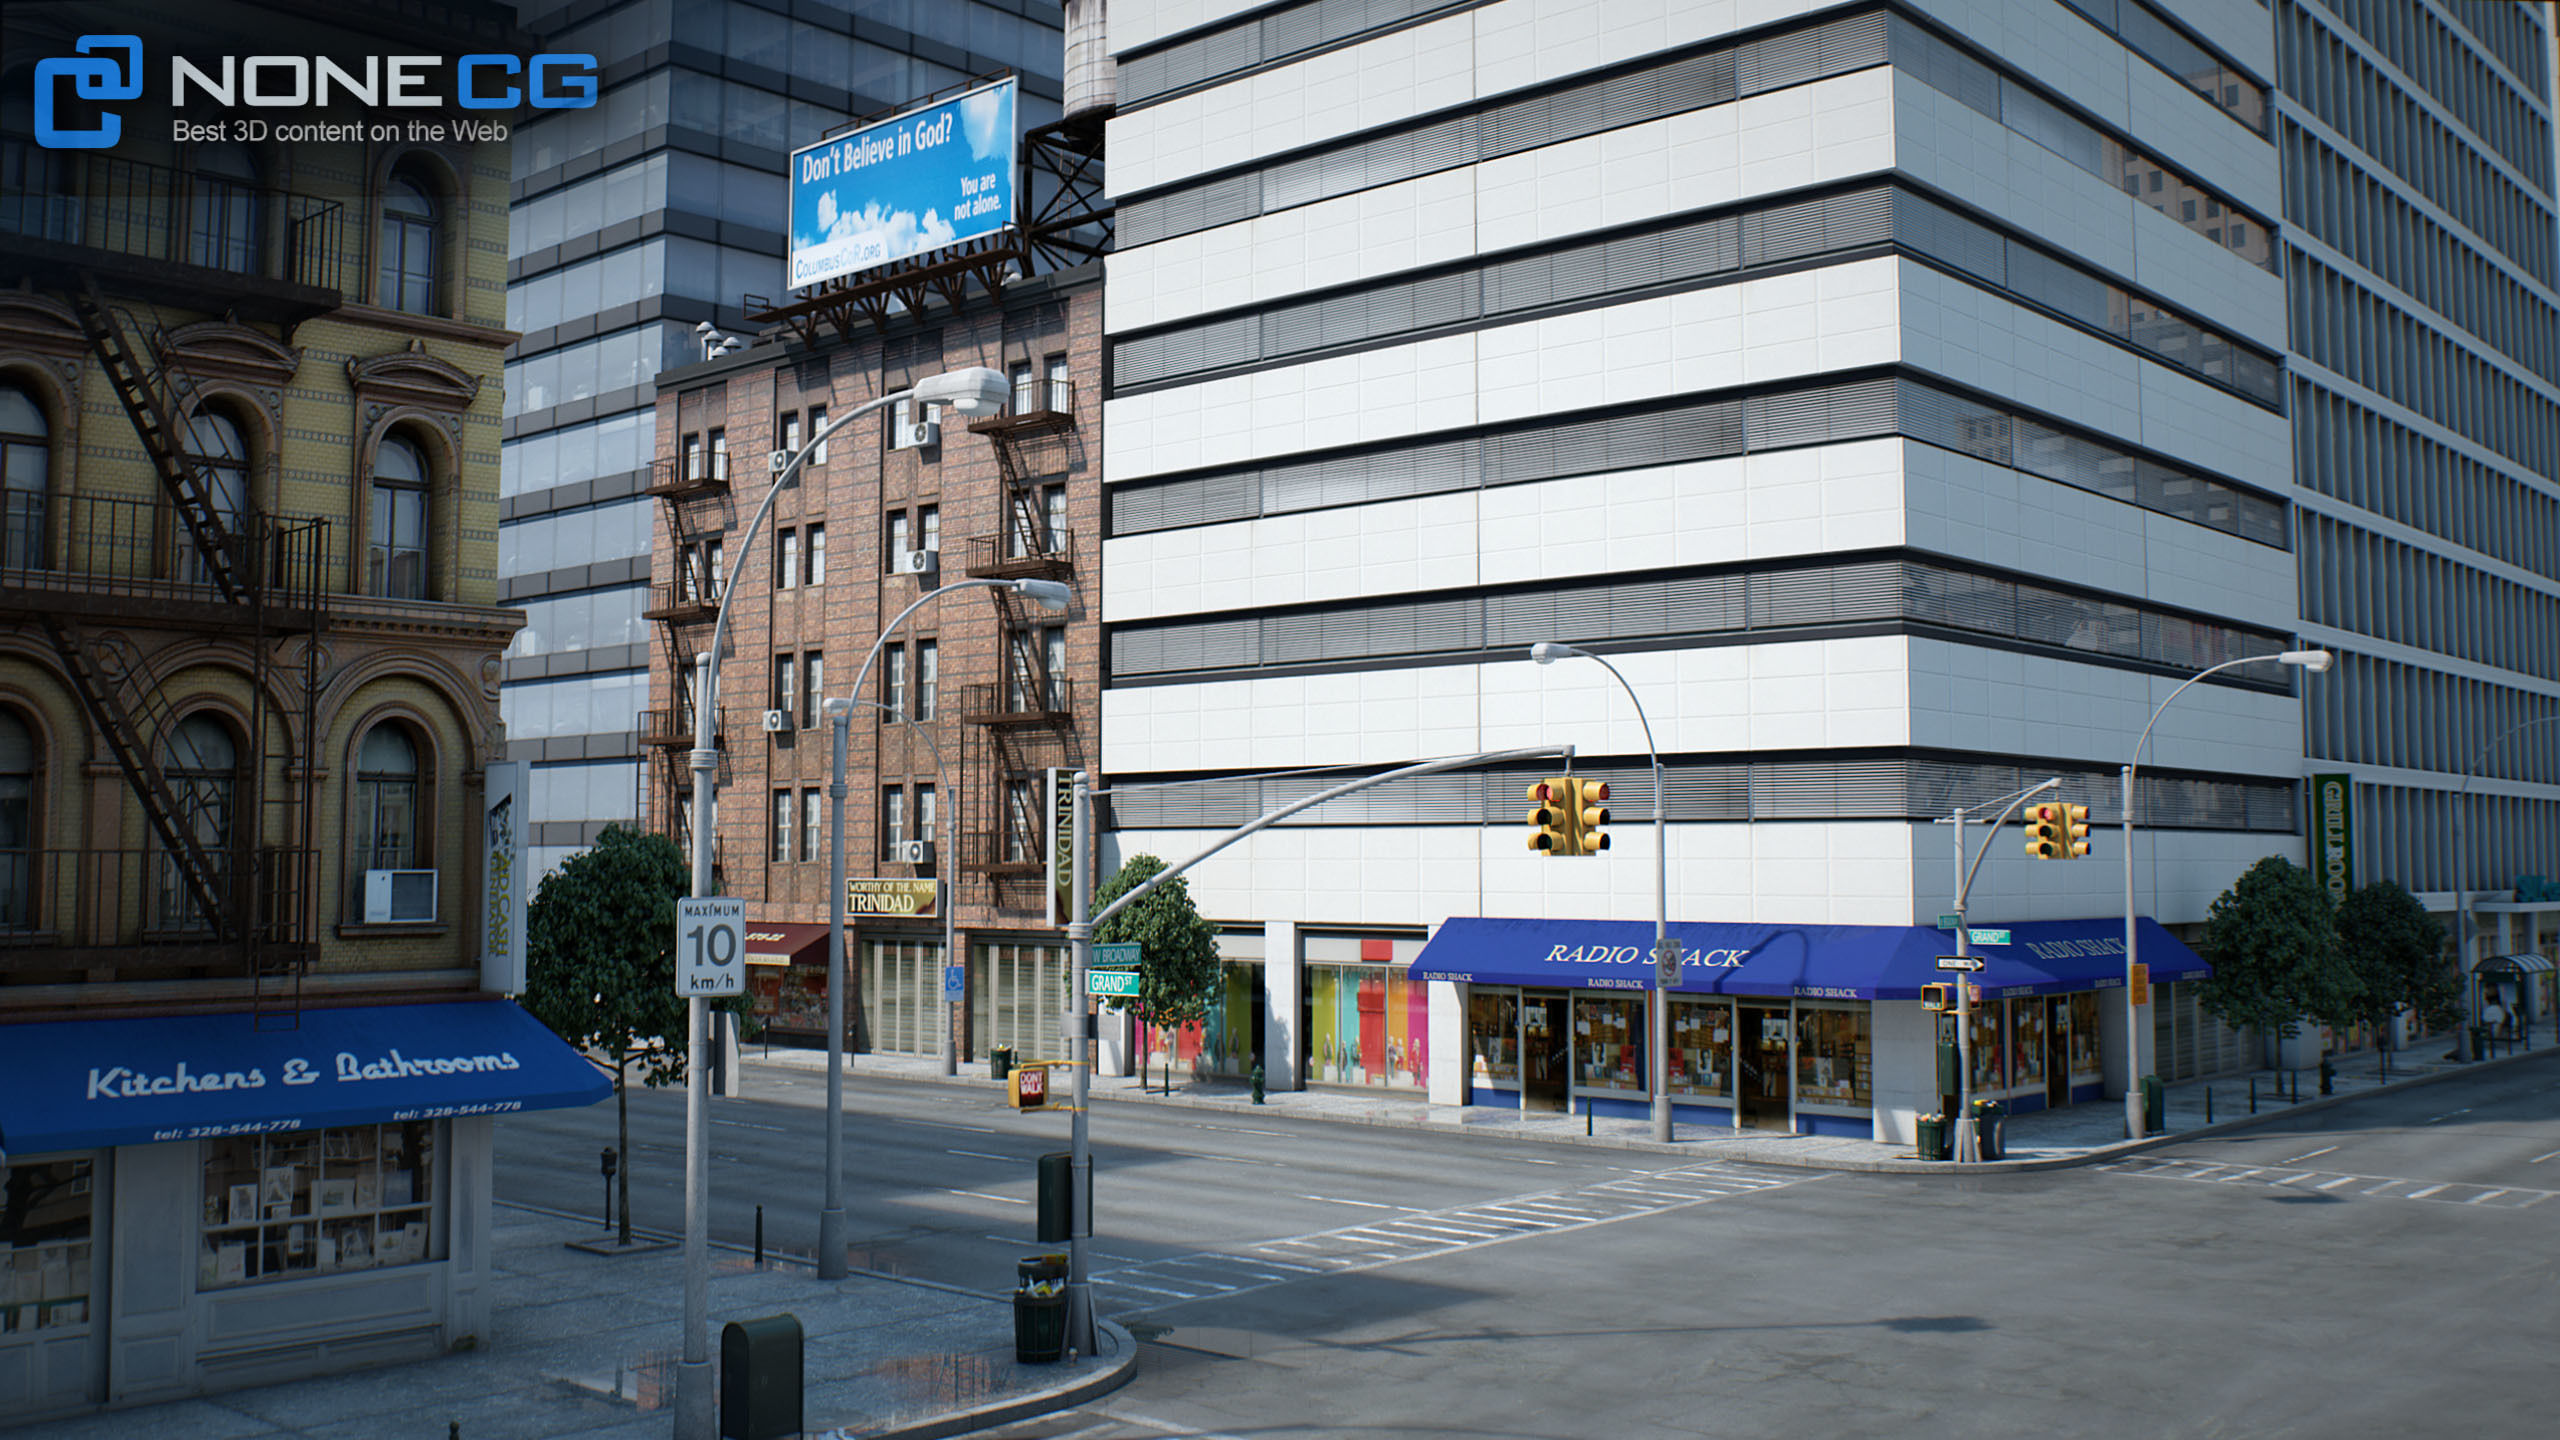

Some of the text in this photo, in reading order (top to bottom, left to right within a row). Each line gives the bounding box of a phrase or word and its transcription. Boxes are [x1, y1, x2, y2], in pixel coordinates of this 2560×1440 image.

[803, 113, 953, 184] Don't Believe in God?
[960, 173, 996, 197] You are
[954, 194, 1001, 221] not alone.
[1057, 773, 1073, 887] TRINIDAD
[849, 882, 880, 893] WORTHY
[883, 882, 893, 893] OF
[896, 882, 911, 893] THE
[848, 893, 914, 912] TRINIDAD
[687, 924, 736, 967] 10
[1972, 931, 1999, 942] GRAND
[1102, 948, 1140, 962] BROADWAY
[1545, 945, 1750, 968] RADIO SACK
[2024, 940, 2085, 959] RADIO
[691, 973, 734, 990] km/h
[1092, 975, 1132, 992] GRAND ST
[1423, 971, 1473, 982] RADIO SHACK
[1588, 978, 1644, 989] RADIO SHACK
[1793, 986, 1857, 998] RADIO SHACK
[87, 1048, 520, 1100] Kitchens & Bathrooms
[1020, 1082, 1043, 1095] WALK
[393, 1101, 522, 1121] tel: 328-544-778
[153, 1119, 301, 1141] tel: 328-544-778
